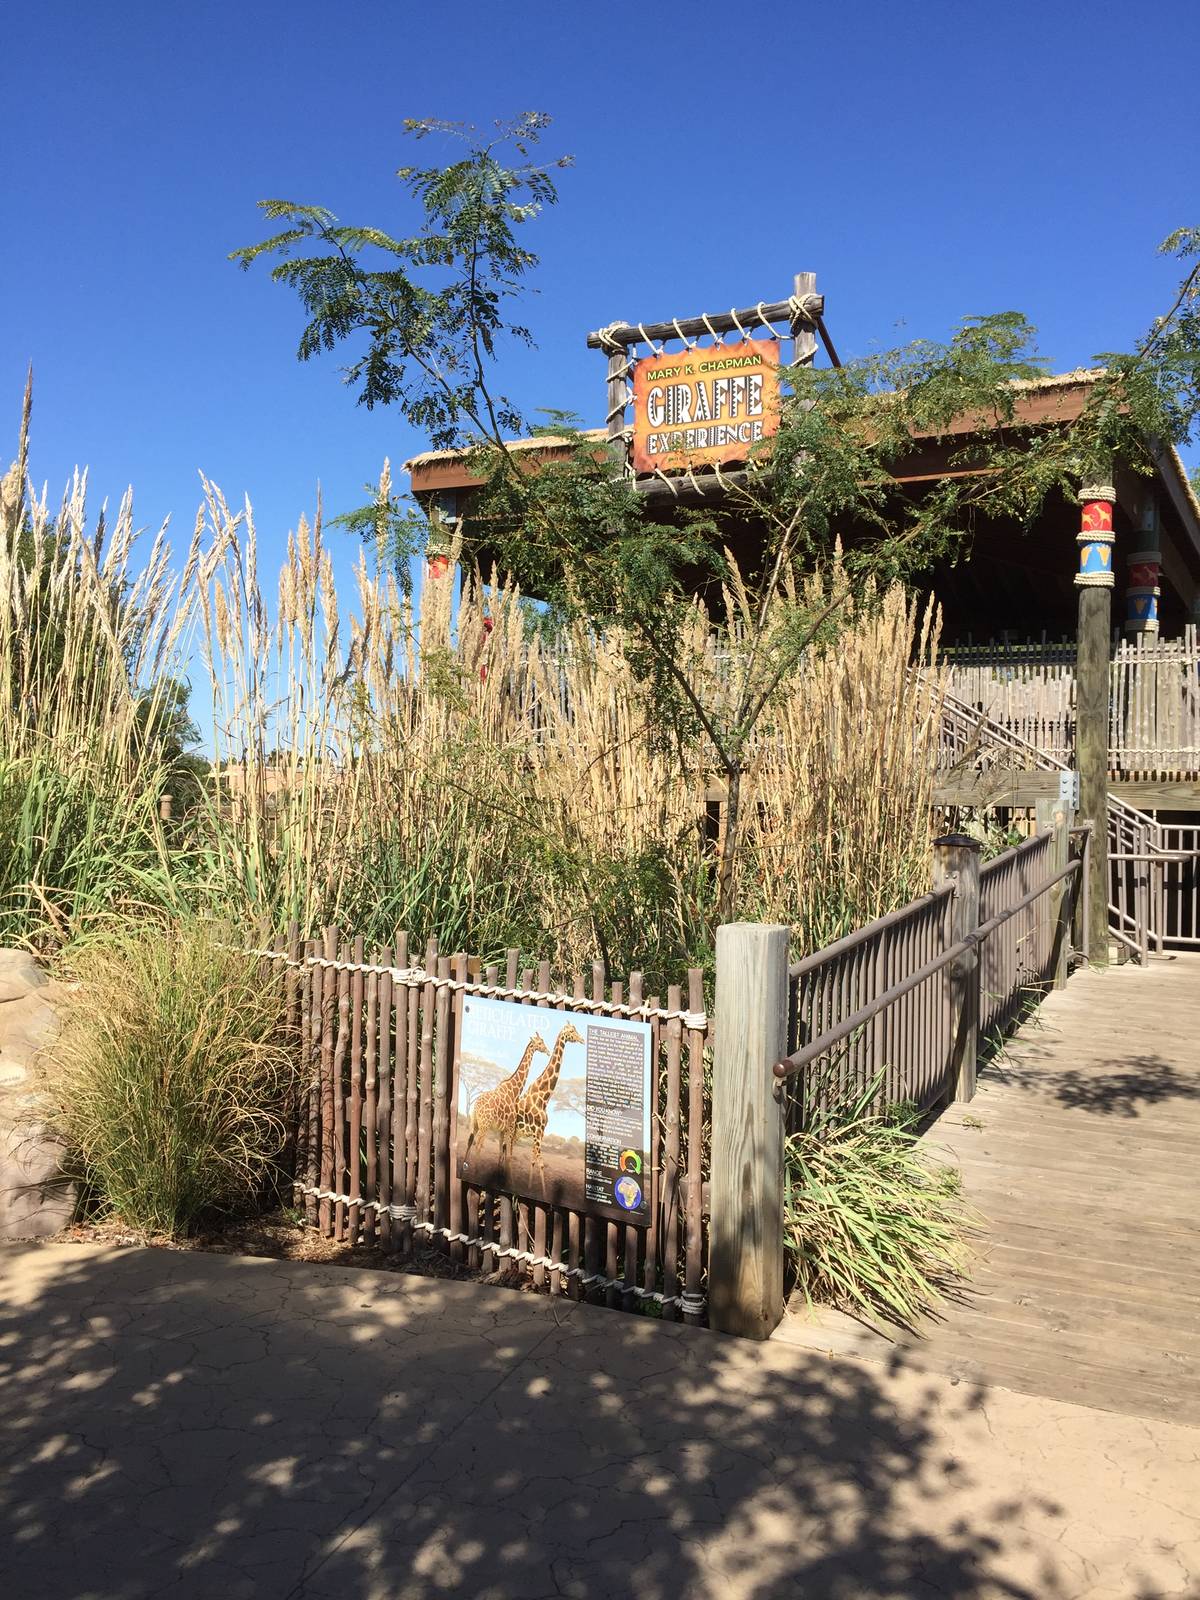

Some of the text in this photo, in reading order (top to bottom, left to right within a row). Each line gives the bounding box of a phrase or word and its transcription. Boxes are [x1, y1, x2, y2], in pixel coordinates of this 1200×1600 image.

[647, 356, 762, 381] MARY K. CHAPMAN
[647, 374, 764, 428] GIRAFFE
[648, 420, 763, 455] EXPERIENCE
